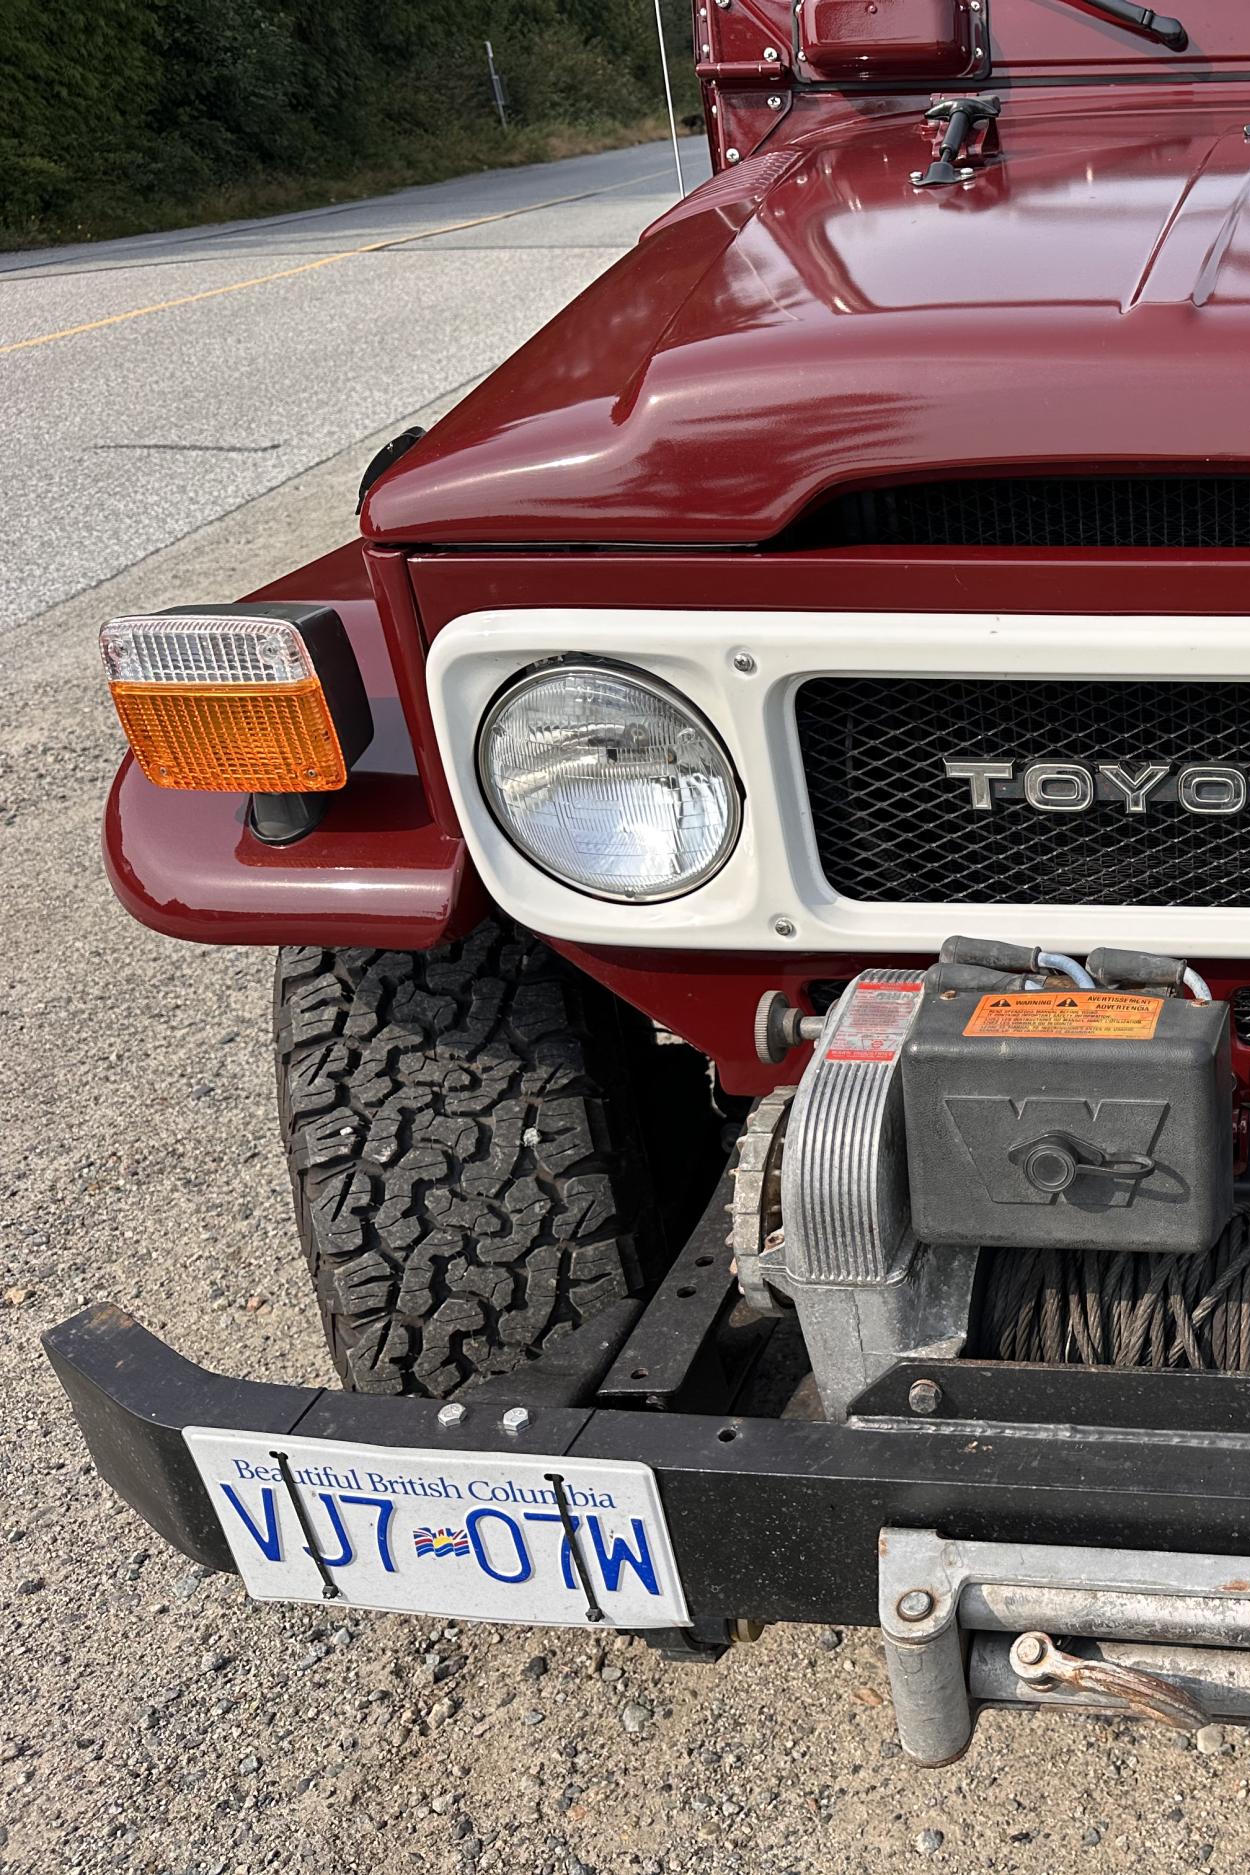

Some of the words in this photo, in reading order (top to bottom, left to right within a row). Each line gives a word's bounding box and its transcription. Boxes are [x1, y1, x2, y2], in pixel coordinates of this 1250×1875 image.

[1015, 999, 1052, 1007] WARNING
[1087, 995, 1152, 1005] AVERTISSEMENT
[1095, 1003, 1150, 1012] ADVERTENCIA
[232, 1458, 364, 1491] Beautiful
[370, 1471, 463, 1500] British
[467, 1479, 617, 1510] Columbia
